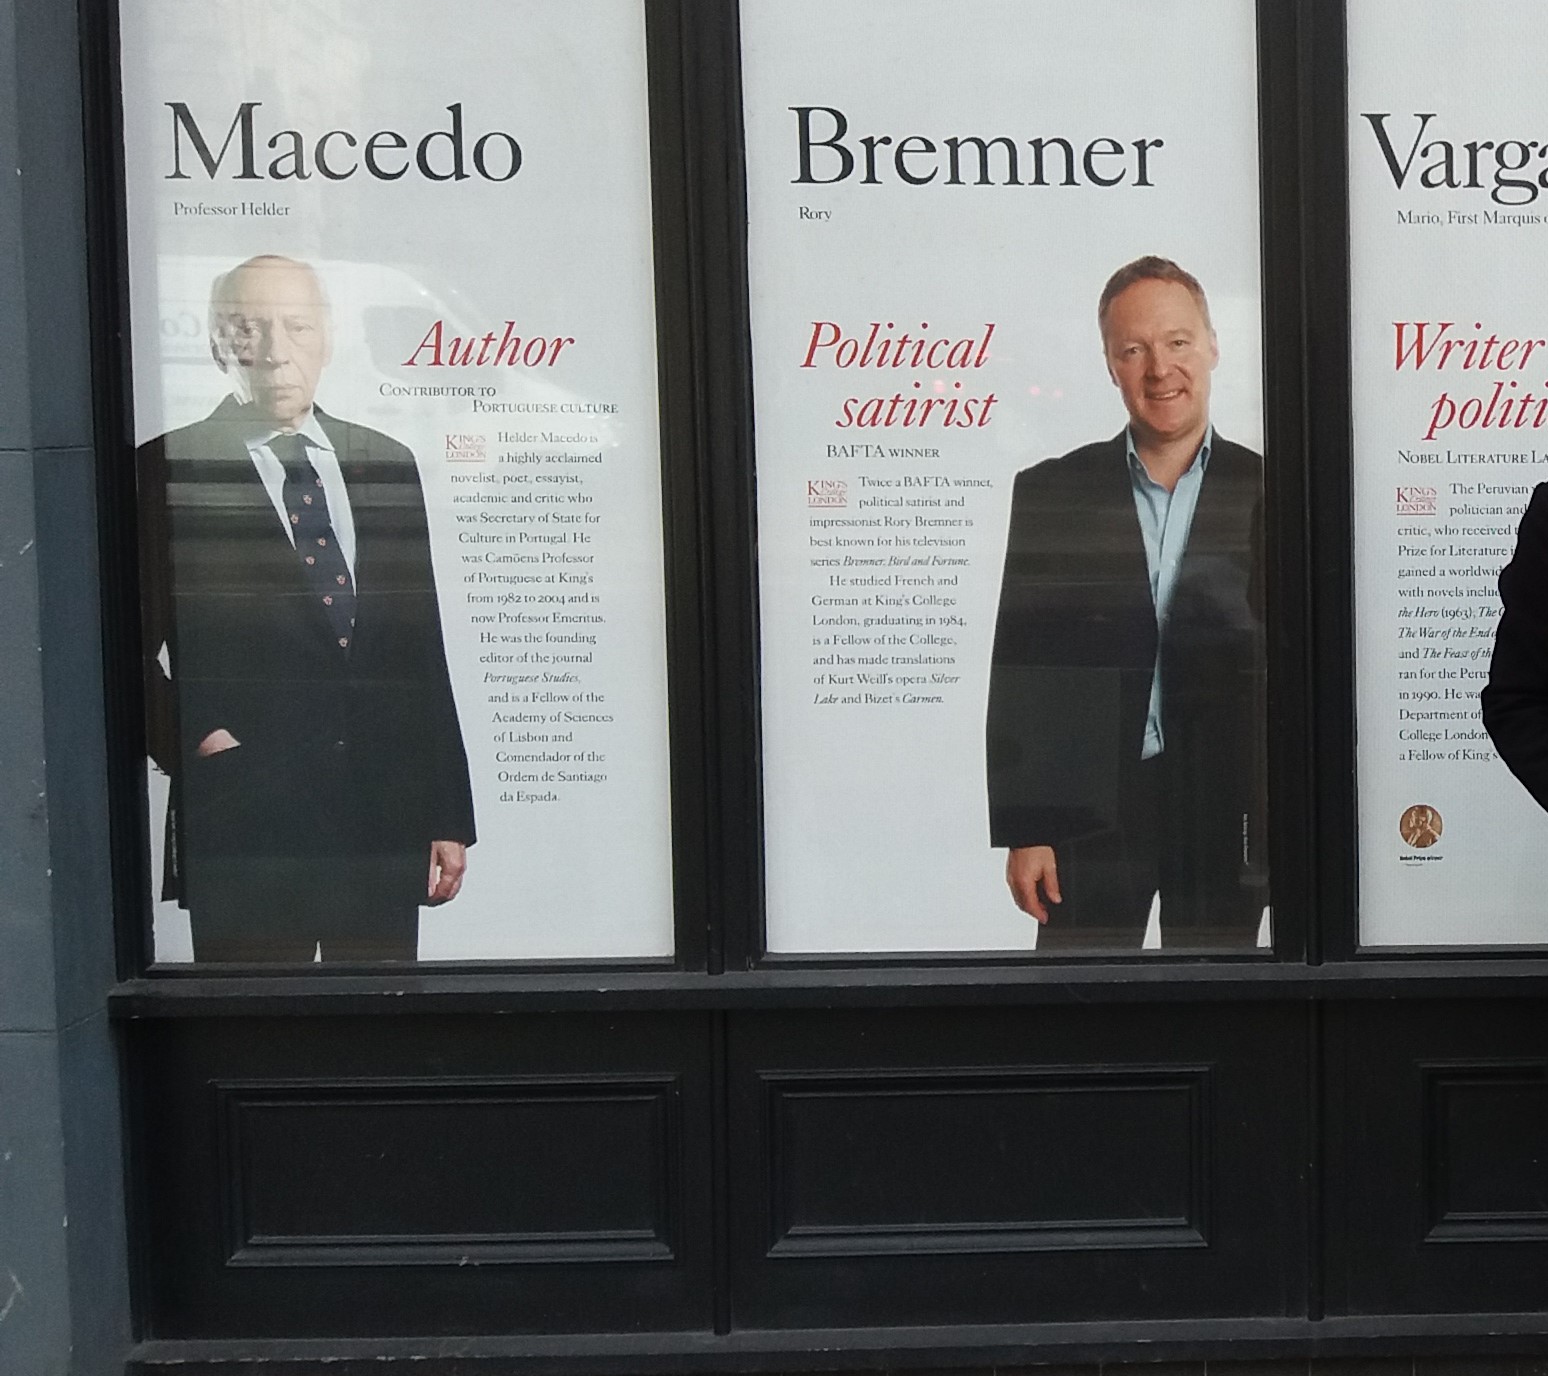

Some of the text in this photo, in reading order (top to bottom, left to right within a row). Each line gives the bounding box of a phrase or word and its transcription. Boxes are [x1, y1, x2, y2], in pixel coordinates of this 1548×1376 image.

[164, 101, 523, 182] Macedo
[787, 106, 1164, 188] Bremner
[173, 202, 290, 217] Professor Helder
[799, 206, 831, 222] Rory
[1397, 210, 1444, 226] Mario,
[1447, 210, 1479, 225] First
[1483, 210, 1541, 227] Marquis
[401, 320, 576, 368] Author
[800, 321, 995, 369] Political
[1392, 322, 1546, 372] Writer
[835, 382, 998, 428] satirist
[826, 444, 885, 458] BAFTA
[1450, 483, 1528, 495] The Peruvian
[858, 497, 965, 509] political satirist and
[1450, 503, 1528, 517] politician and
[1434, 525, 1459, 536] who
[1462, 525, 1512, 536] received
[809, 536, 966, 547] best known for his television
[1398, 545, 1508, 556] Prize for Literature
[1397, 566, 1436, 579] gained
[829, 575, 958, 586] He studied French and
[1398, 586, 1464, 598] with novels
[467, 593, 494, 603] from
[497, 593, 522, 605] 1982
[524, 594, 536, 603] to
[567, 593, 589, 603] and
[811, 595, 957, 607] German at King's College
[471, 615, 495, 624] now
[498, 612, 549, 623] Professor
[863, 615, 923, 627] graduating
[925, 616, 936, 626] in
[479, 652, 593, 665] editor of the journal
[492, 712, 614, 724] Academy of Sciences
[1399, 709, 1483, 721] Department of
[493, 732, 573, 742] of Lisbon and
[1399, 729, 1489, 742] College London
[495, 751, 605, 762] Comendador of the
[1399, 750, 1498, 762] a Fellow of King's
[497, 771, 607, 783] Ordem de Santiago
